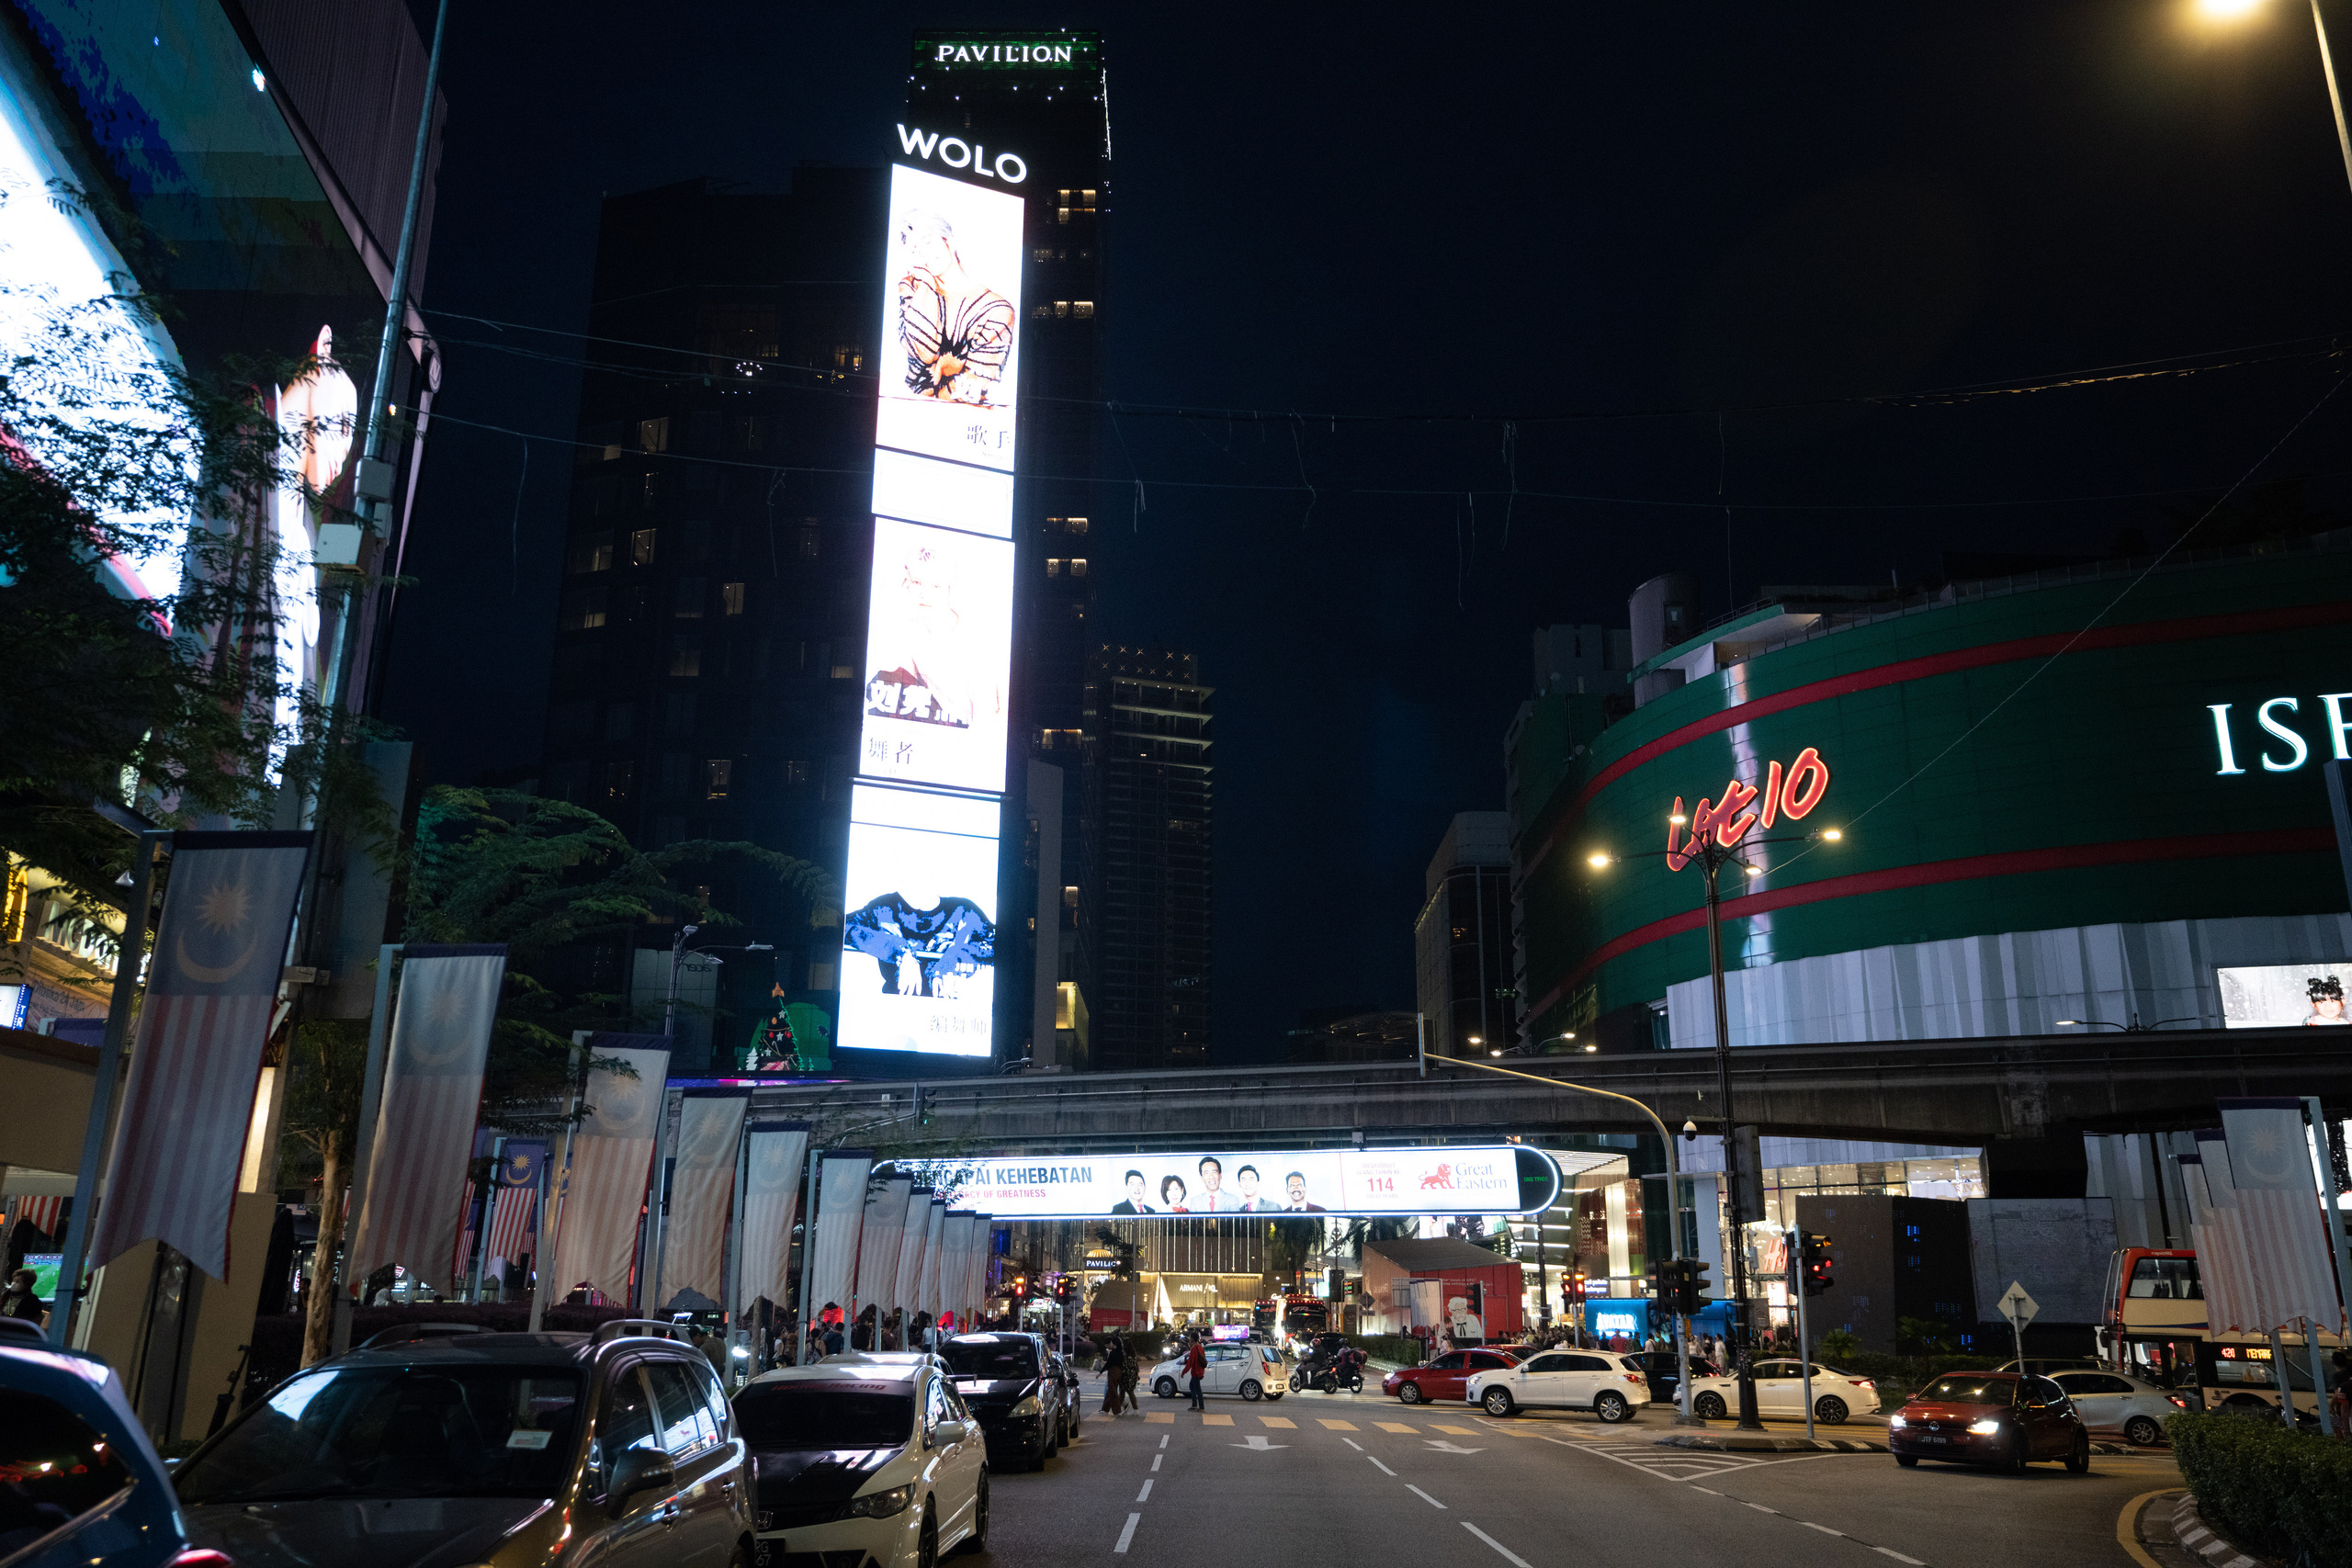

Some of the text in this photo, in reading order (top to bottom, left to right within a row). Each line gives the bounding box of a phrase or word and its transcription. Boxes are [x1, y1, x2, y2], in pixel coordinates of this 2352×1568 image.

[938, 46, 1071, 62] PAVILION
[897, 123, 1027, 183] WOLO
[1667, 747, 1829, 872] Lot 10
[1455, 1163, 1494, 1176] Great
[913, 1167, 1092, 1187] NCAPAI KEHEBATAN
[1456, 1177, 1508, 1190] Eastern
[1367, 1177, 1395, 1191] 114
[996, 1189, 1046, 1198] GREATNESS
[1763, 1238, 1788, 1273] H&
[1086, 1259, 1116, 1268] PAVILIO
[1179, 1284, 1203, 1292] ARMANI
[2222, 1348, 2235, 1359] 420
